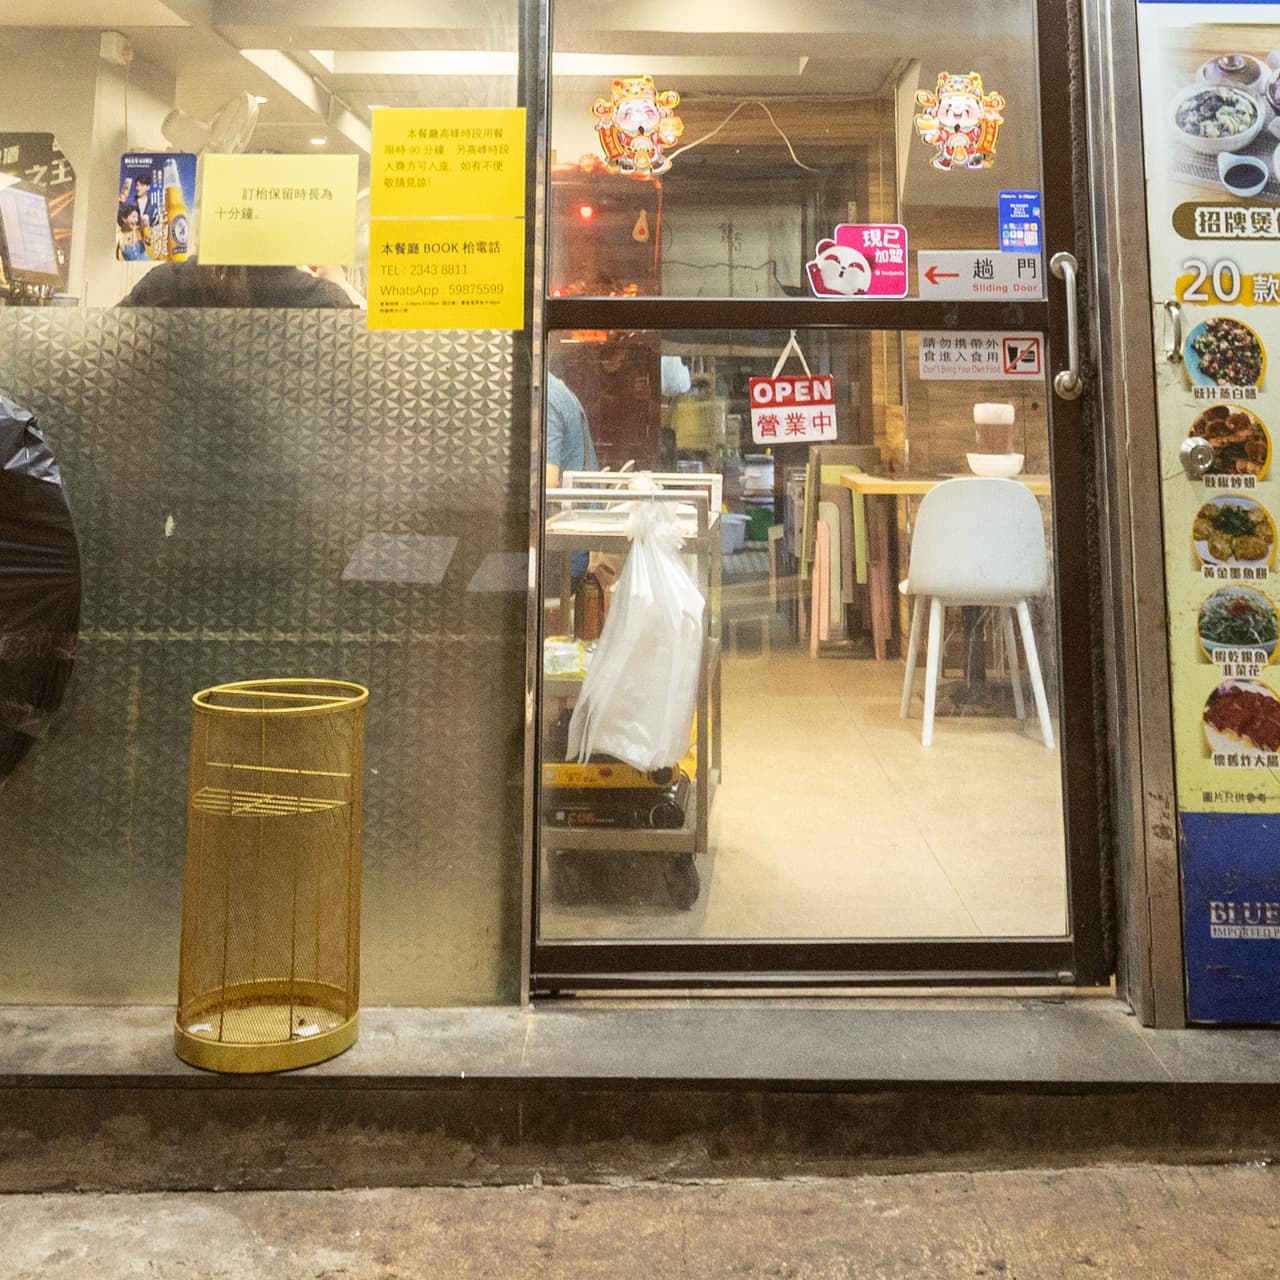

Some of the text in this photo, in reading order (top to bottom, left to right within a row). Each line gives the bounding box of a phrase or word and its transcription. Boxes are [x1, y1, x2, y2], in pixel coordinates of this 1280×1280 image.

[862, 229, 900, 249] 現已
[423, 242, 459, 254] BOOK
[875, 249, 904, 264] 加盟
[972, 283, 1037, 293] Sliding Door
[1182, 259, 1242, 302] 20
[380, 284, 439, 297] WhatsApp
[753, 381, 832, 404] OPEN
[757, 411, 833, 438] 營業中
[1209, 902, 1279, 925] BLUE
[1212, 926, 1272, 938] IMPORTED
